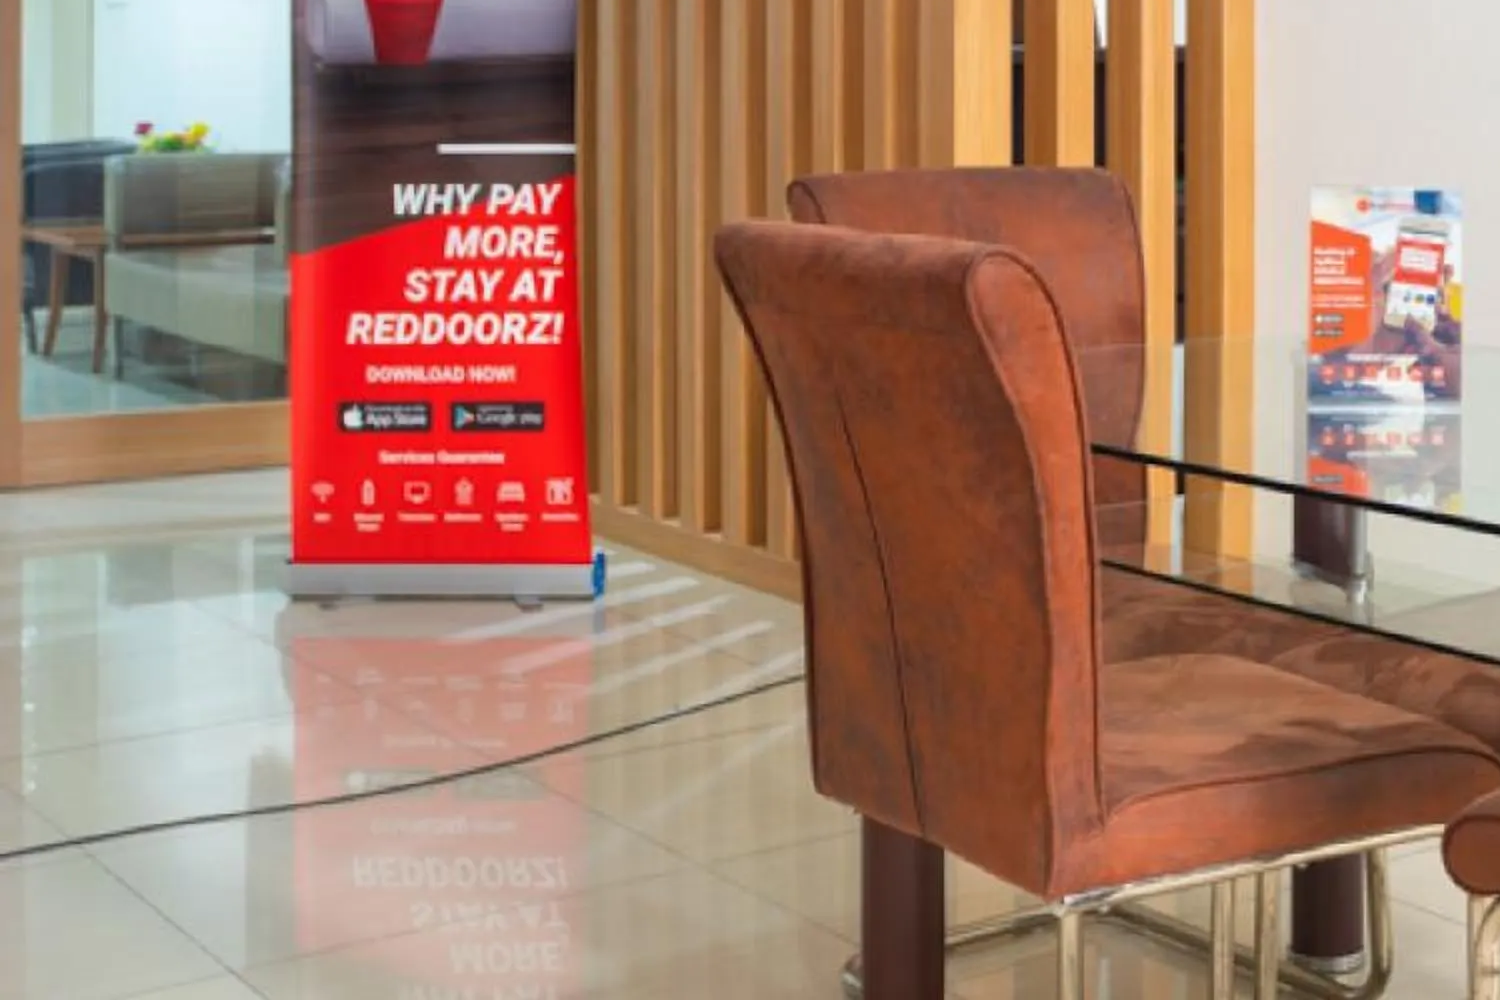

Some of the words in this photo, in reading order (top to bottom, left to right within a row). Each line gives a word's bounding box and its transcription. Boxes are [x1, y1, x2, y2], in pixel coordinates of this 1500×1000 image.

[393, 183, 479, 215] WHY
[486, 183, 561, 215] PAY
[444, 226, 563, 264] MORE,
[403, 270, 503, 303] STAY
[510, 270, 562, 302] AT
[346, 313, 563, 345] REDDOORZ!
[365, 365, 465, 384] DOWNLOAD
[469, 365, 517, 383] NOW!
